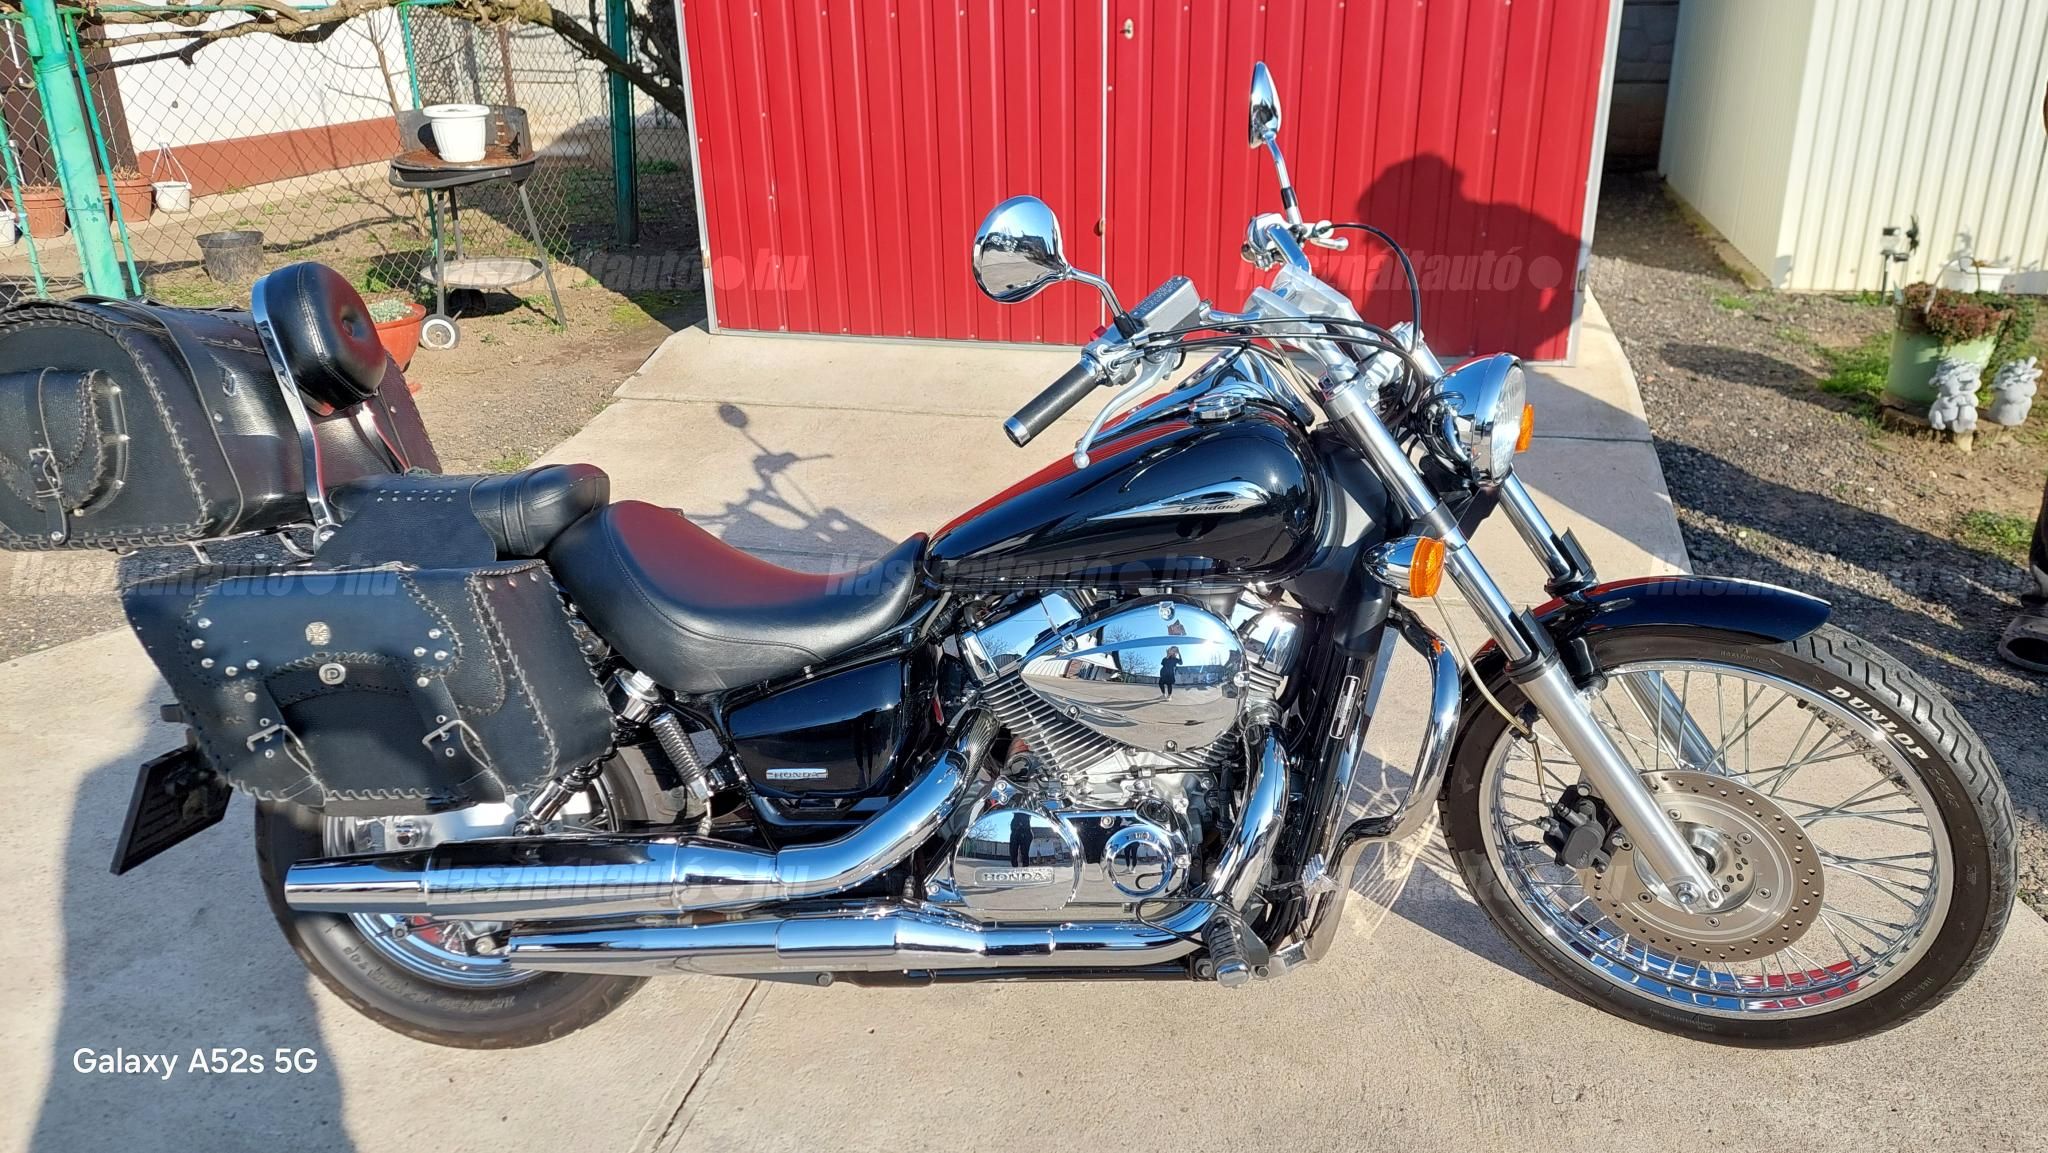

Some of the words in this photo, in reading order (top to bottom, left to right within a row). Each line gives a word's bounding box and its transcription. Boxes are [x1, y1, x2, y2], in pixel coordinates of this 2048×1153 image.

[1827, 686, 1929, 760] DUNLOP
[774, 771, 819, 779] HONDA
[984, 872, 1045, 882] HONDA
